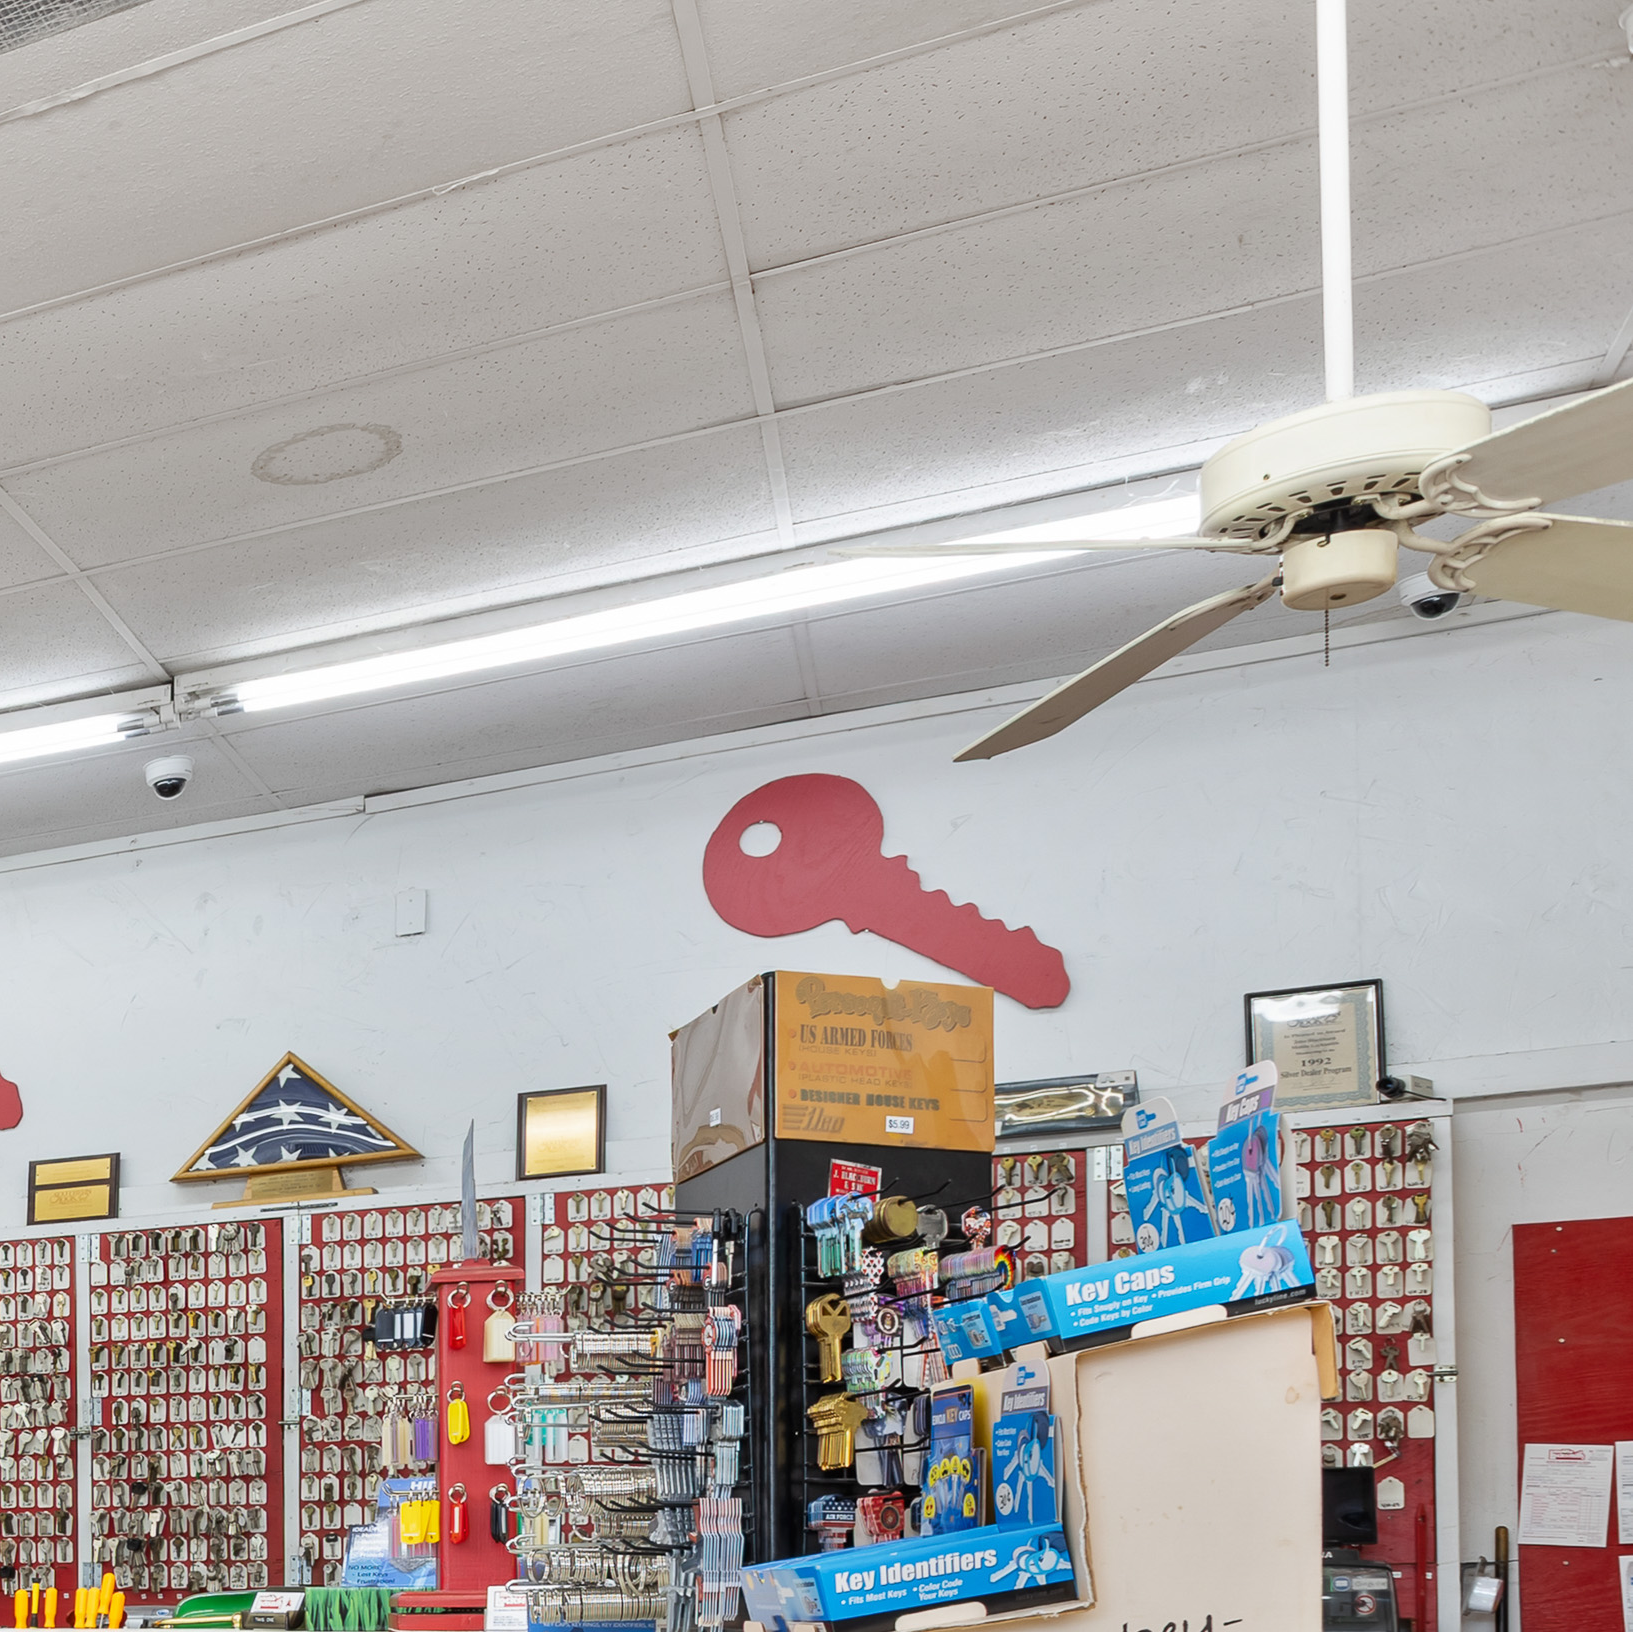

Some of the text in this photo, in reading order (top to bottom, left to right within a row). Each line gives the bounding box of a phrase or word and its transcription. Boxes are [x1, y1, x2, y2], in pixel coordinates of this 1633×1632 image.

[800, 1024, 914, 1052] US ARMED FORCES
[799, 1061, 913, 1081] AUTOMOTIVE
[1301, 1057, 1332, 1068] 1992
[851, 1077, 881, 1087] HEAD
[1280, 1065, 1353, 1080] Silver Dealer Program
[800, 1088, 941, 1112] DESIGNER HOUSE KEYS
[888, 1118, 910, 1130] $5.99
[1065, 1265, 1176, 1307] Key Caps
[1157, 1275, 1231, 1298] Provides Firm Grip
[1077, 1295, 1149, 1316] Fits Snugly on Key
[1079, 1303, 1153, 1327] Code Keys by Color
[825, 1512, 837, 1521] AIR
[835, 1549, 998, 1594] Key Identifiers
[918, 1577, 963, 1593] Color Code
[918, 1588, 959, 1601] Your Keys
[848, 1587, 908, 1606] Fits Most Keys
